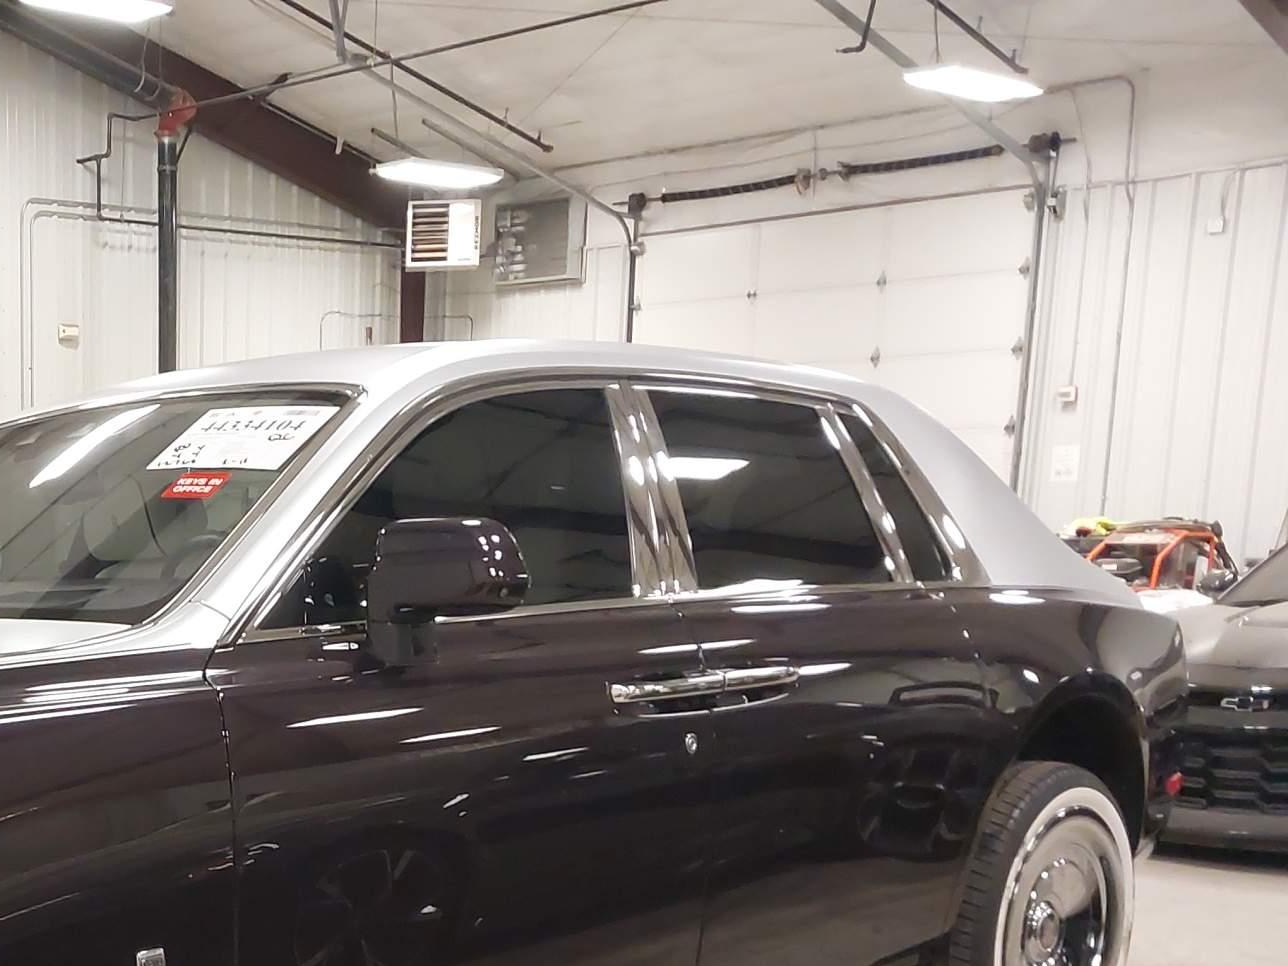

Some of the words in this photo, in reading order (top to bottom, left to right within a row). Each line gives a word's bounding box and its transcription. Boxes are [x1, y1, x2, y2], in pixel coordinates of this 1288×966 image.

[176, 477, 208, 485] KEYS
[208, 477, 224, 485] IN
[172, 485, 214, 493] OFFICE
